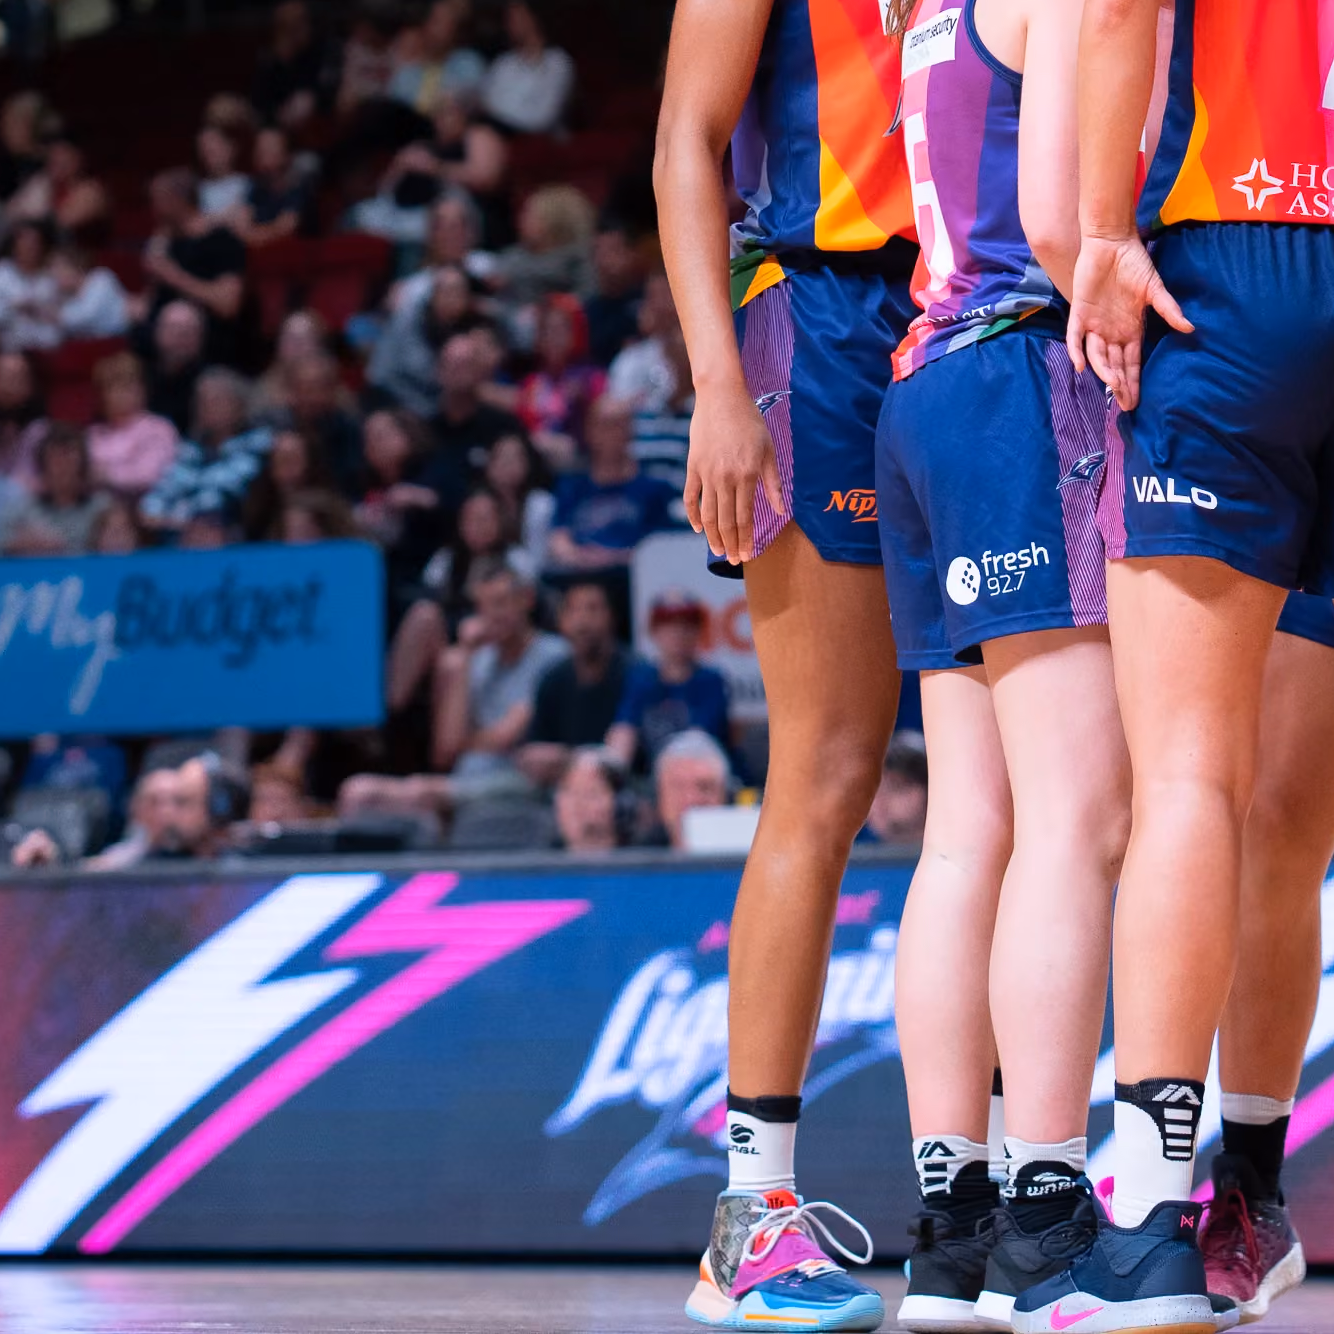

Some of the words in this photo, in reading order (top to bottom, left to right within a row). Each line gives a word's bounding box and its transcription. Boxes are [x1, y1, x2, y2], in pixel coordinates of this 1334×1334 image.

[1132, 475, 1218, 510] VALO
[981, 541, 1050, 578] fresh
[986, 570, 1026, 597] 92.7
